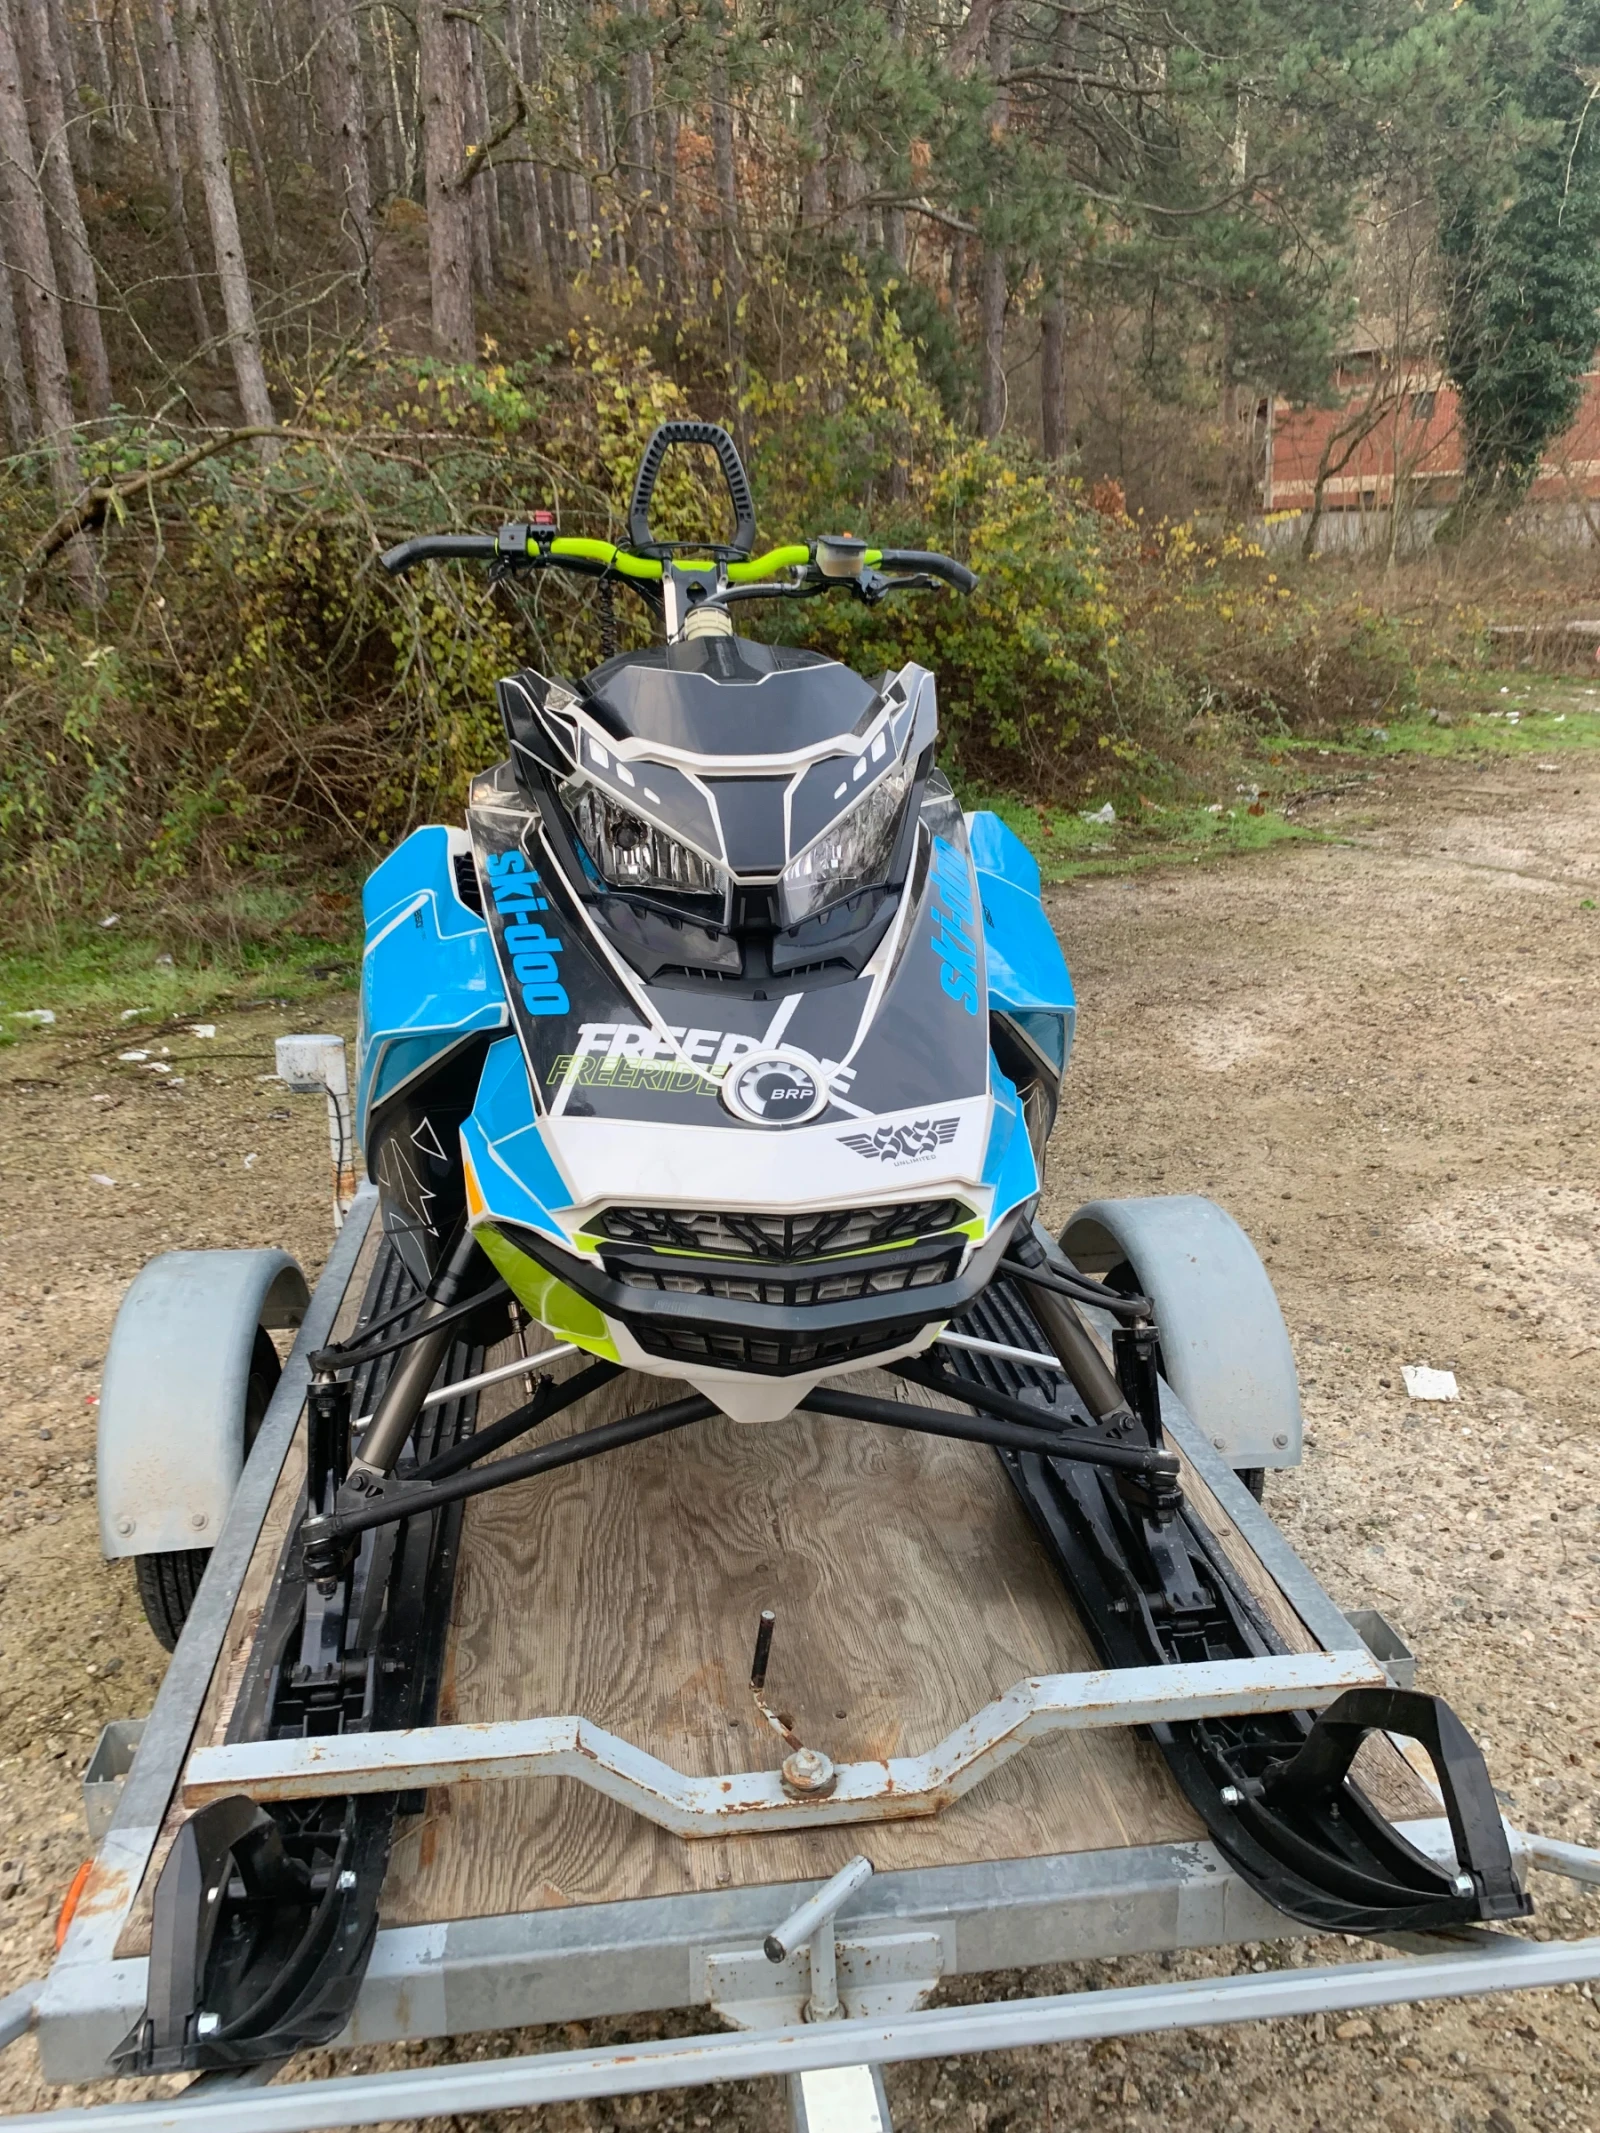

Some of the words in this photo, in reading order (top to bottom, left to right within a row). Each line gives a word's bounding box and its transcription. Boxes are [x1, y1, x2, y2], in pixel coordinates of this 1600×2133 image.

[486, 850, 570, 1015] ski-doo
[546, 1055, 729, 1096] FREERIDE
[770, 1088, 815, 1100] BRP
[893, 1154, 937, 1167] UNLIMITED
